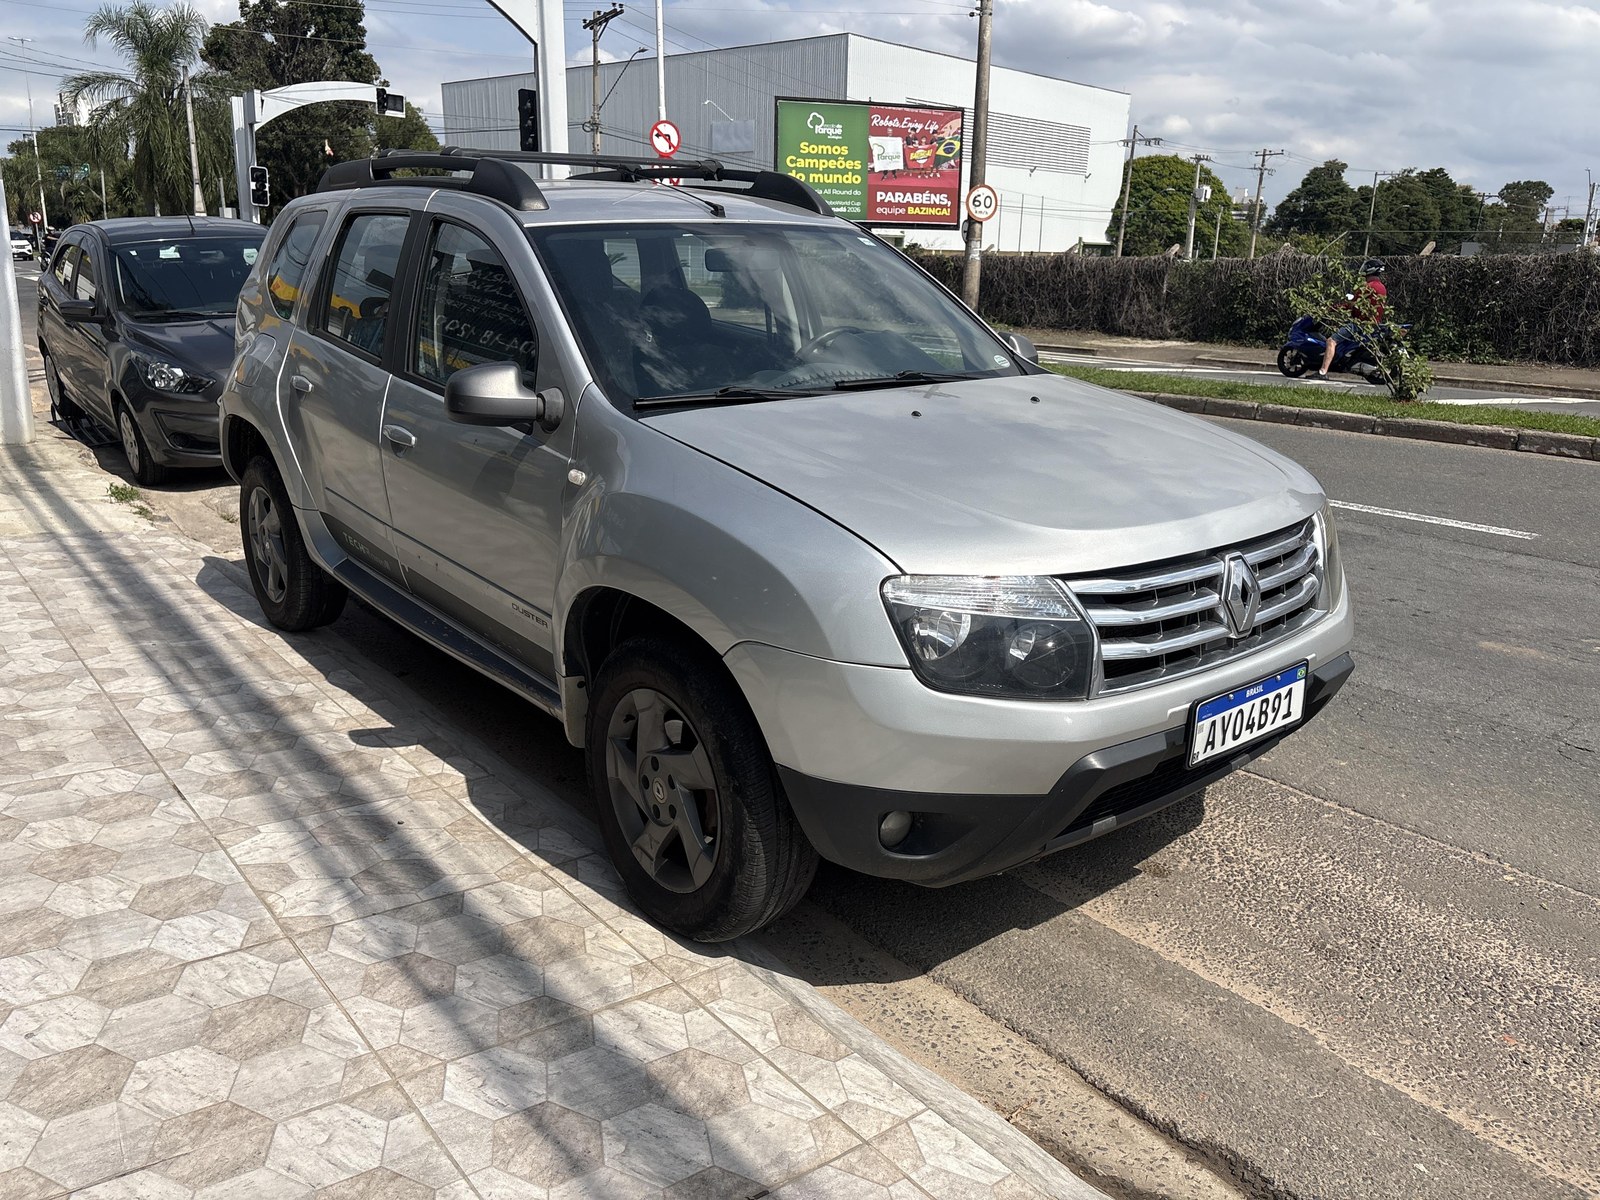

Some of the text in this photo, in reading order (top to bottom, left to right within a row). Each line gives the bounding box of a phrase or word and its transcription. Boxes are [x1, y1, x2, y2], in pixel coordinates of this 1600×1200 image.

[799, 141, 849, 155] Somos
[785, 155, 862, 171] Campeões
[809, 171, 862, 184] mundo
[876, 191, 951, 207] PARABÉNS,
[972, 194, 993, 209] 60
[876, 205, 951, 216] equipe BAZINGA!
[511, 602, 549, 629] DUSTER
[1245, 684, 1264, 698] BRASIL
